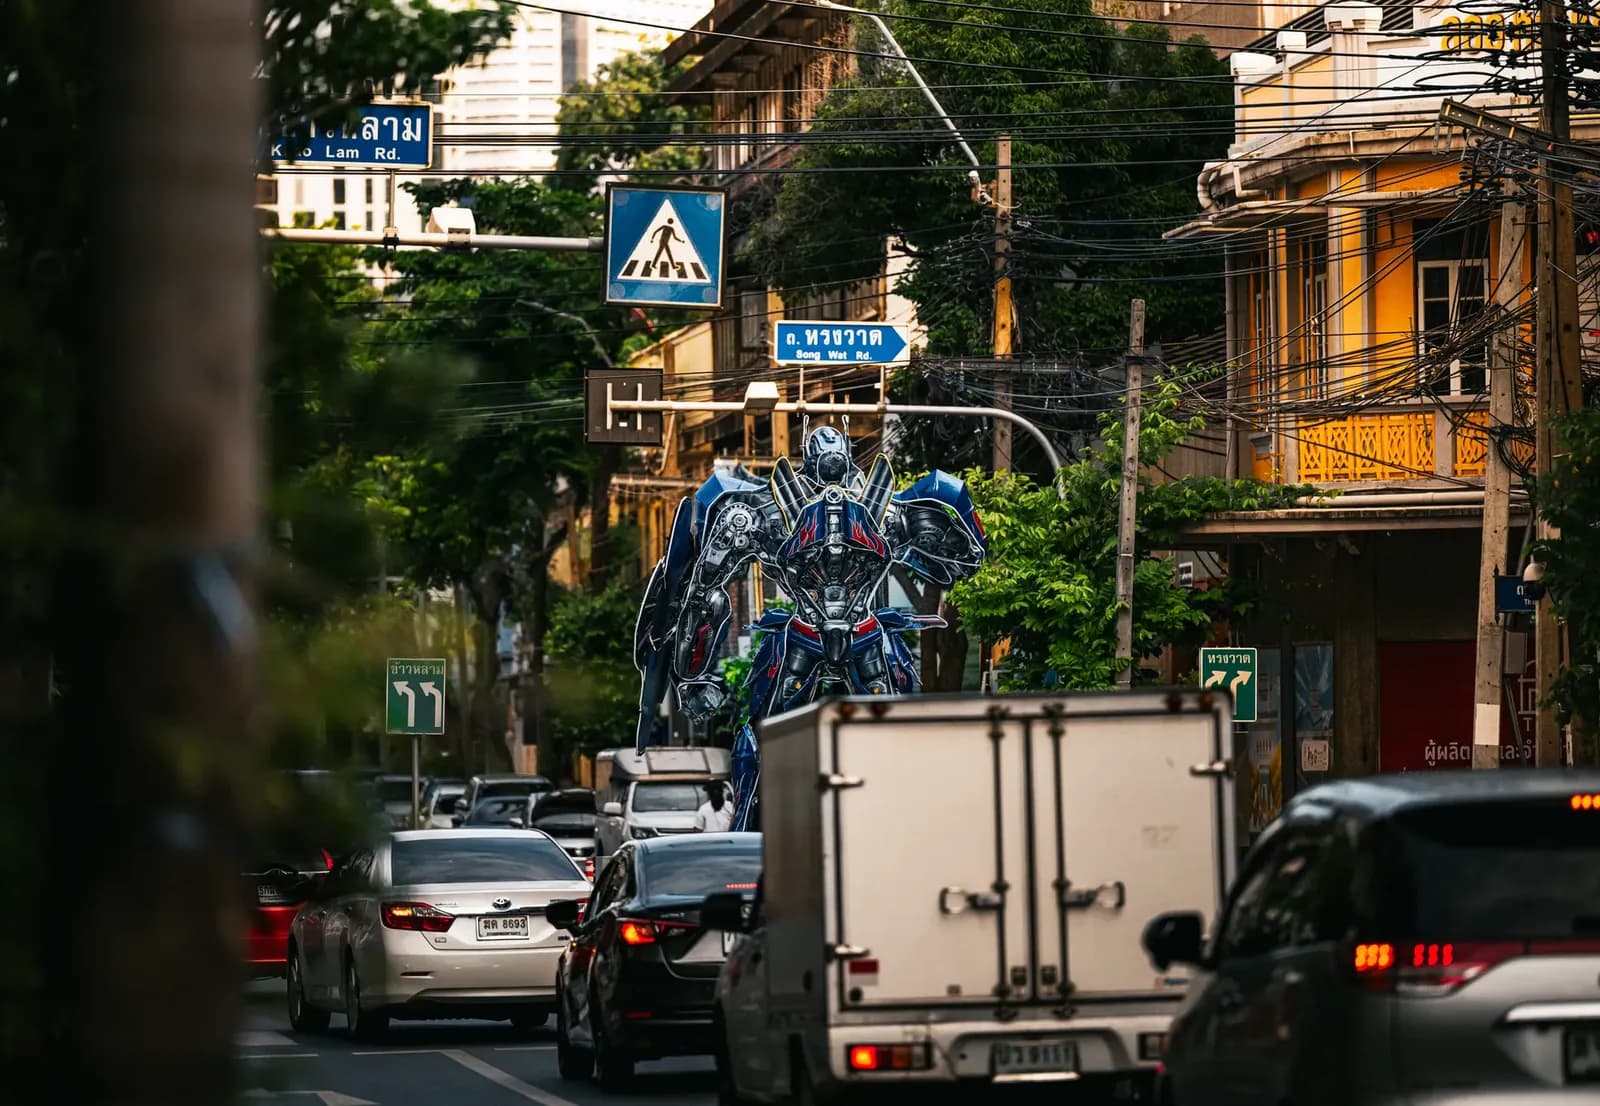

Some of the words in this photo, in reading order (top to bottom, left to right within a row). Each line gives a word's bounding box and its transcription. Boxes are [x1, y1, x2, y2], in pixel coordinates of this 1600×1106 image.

[271, 144, 312, 157] Ko
[325, 145, 359, 159] Lam
[374, 147, 401, 160] Rd.
[804, 328, 883, 346] ทรงวาด
[796, 349, 821, 361] Song
[828, 350, 847, 360] Wat
[856, 351, 873, 361] Rd.
[1424, 738, 1470, 767] ผู้ผลิต
[502, 918, 526, 929] 8693
